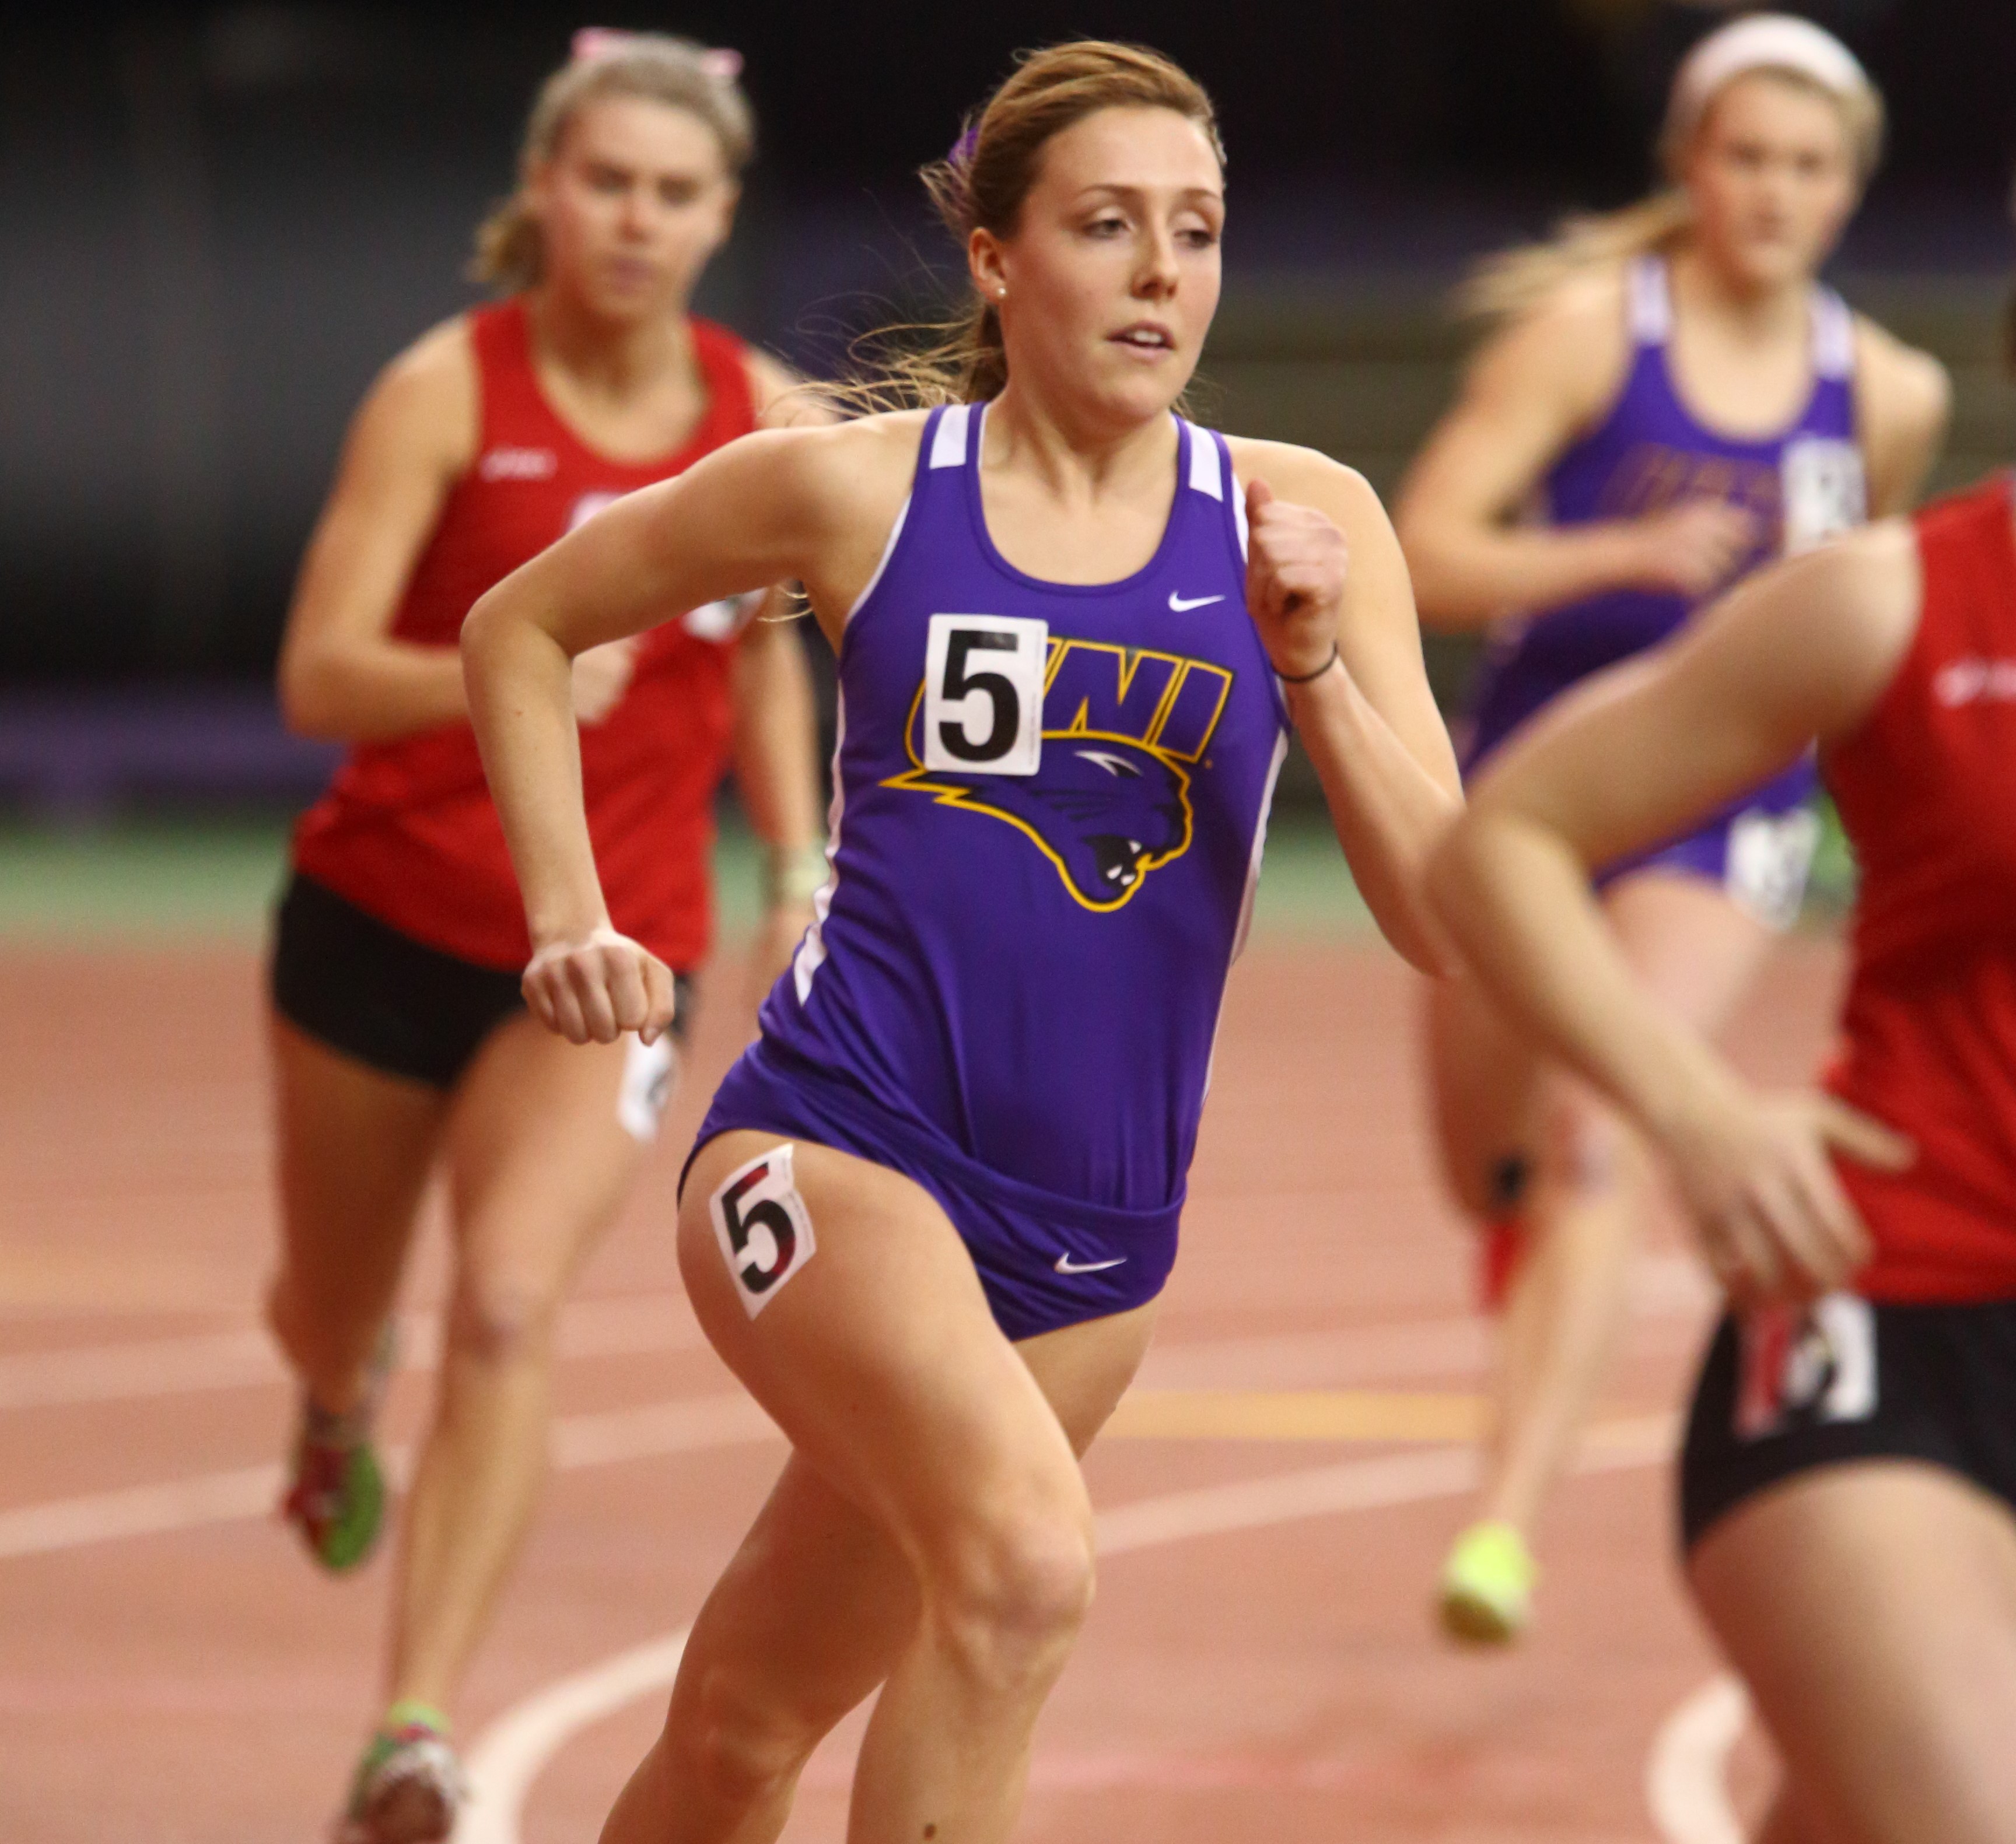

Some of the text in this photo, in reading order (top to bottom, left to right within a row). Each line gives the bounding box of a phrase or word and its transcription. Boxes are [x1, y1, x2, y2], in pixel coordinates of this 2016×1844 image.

[938, 629, 1020, 763] 5
[1042, 635, 1235, 765] NI
[721, 1162, 796, 1294] 5
